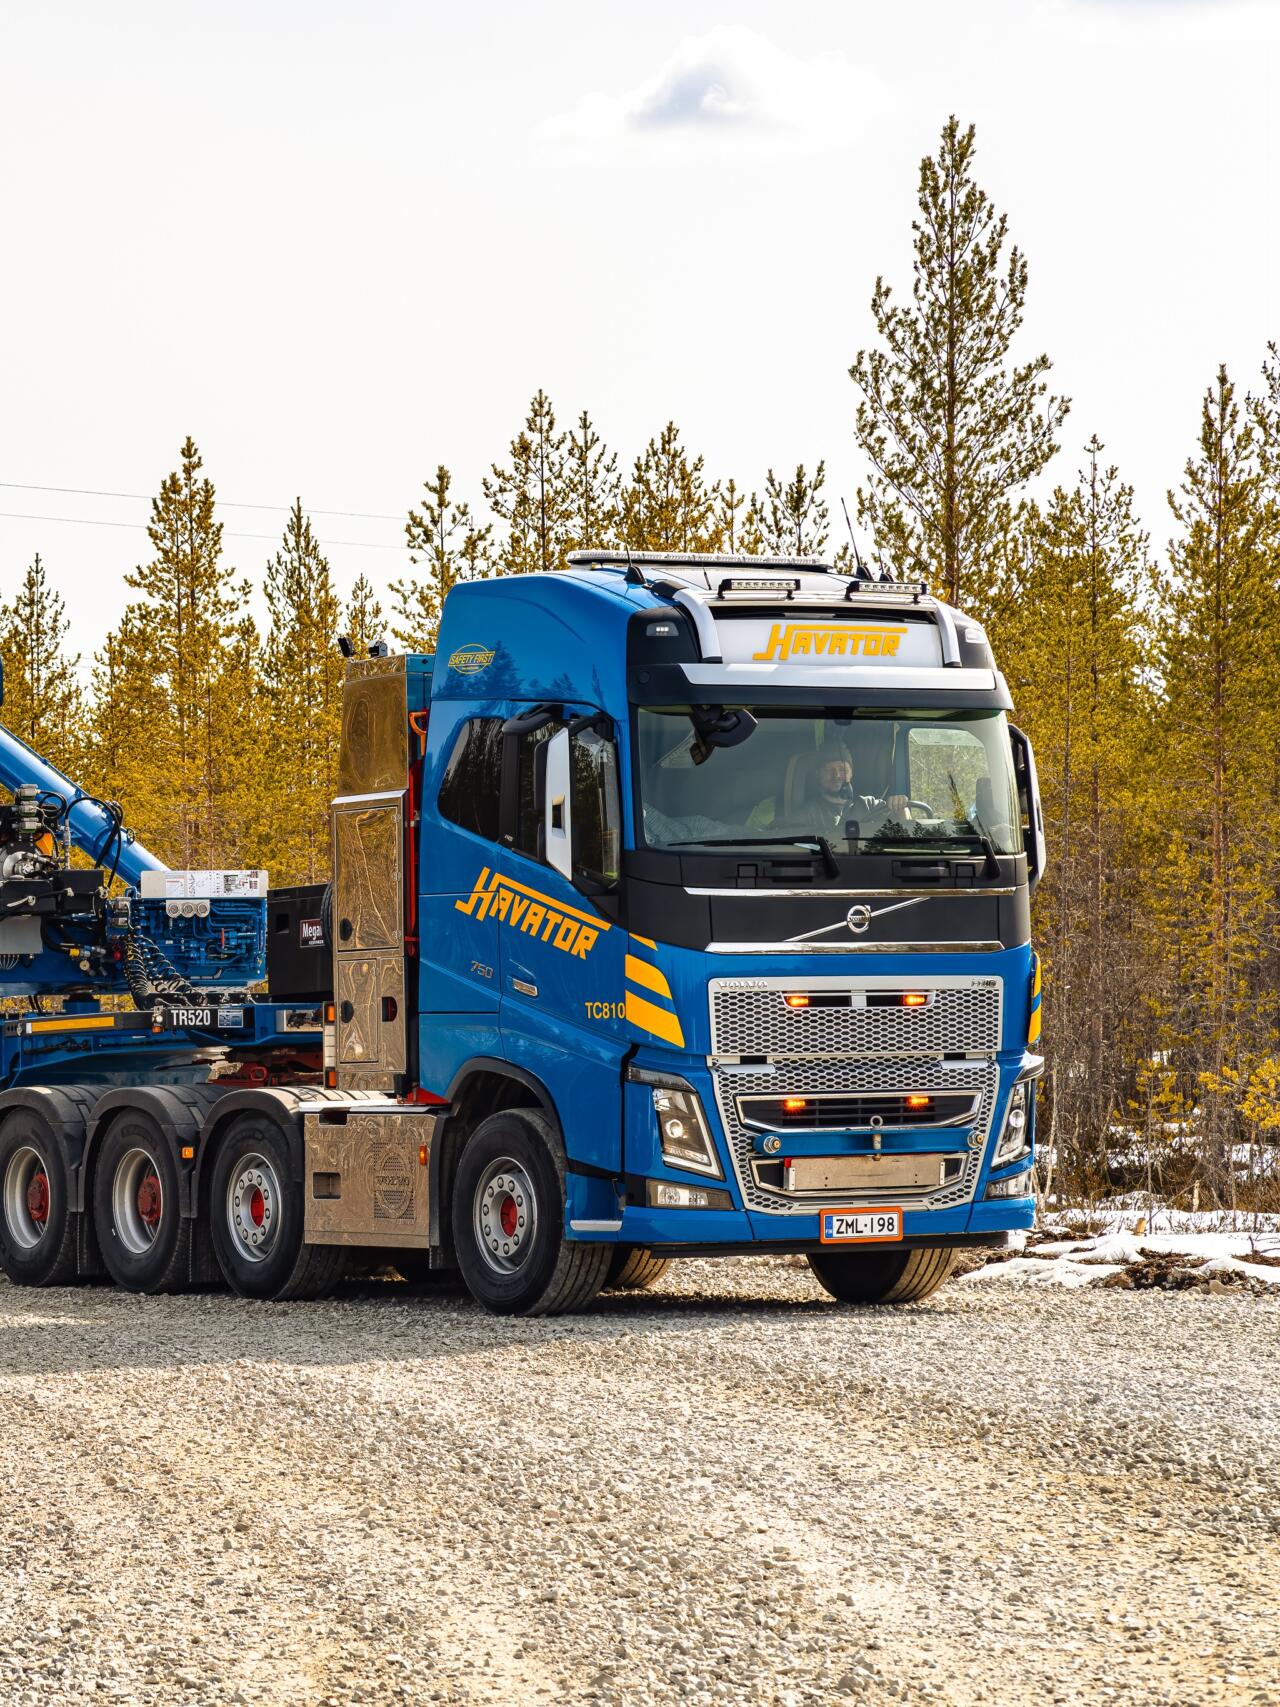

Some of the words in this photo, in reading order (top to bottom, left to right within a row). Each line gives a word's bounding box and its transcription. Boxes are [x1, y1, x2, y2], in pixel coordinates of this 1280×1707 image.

[752, 624, 908, 661] HAVATOR
[451, 654, 475, 665] SAFETY
[474, 652, 494, 663] FIRST
[454, 866, 612, 960] HAVATOR
[303, 923, 323, 940] Mega
[471, 960, 494, 978] 750
[170, 1009, 211, 1026] TR520
[585, 1002, 626, 1019] TC810
[836, 1216, 895, 1235] ZML-198
